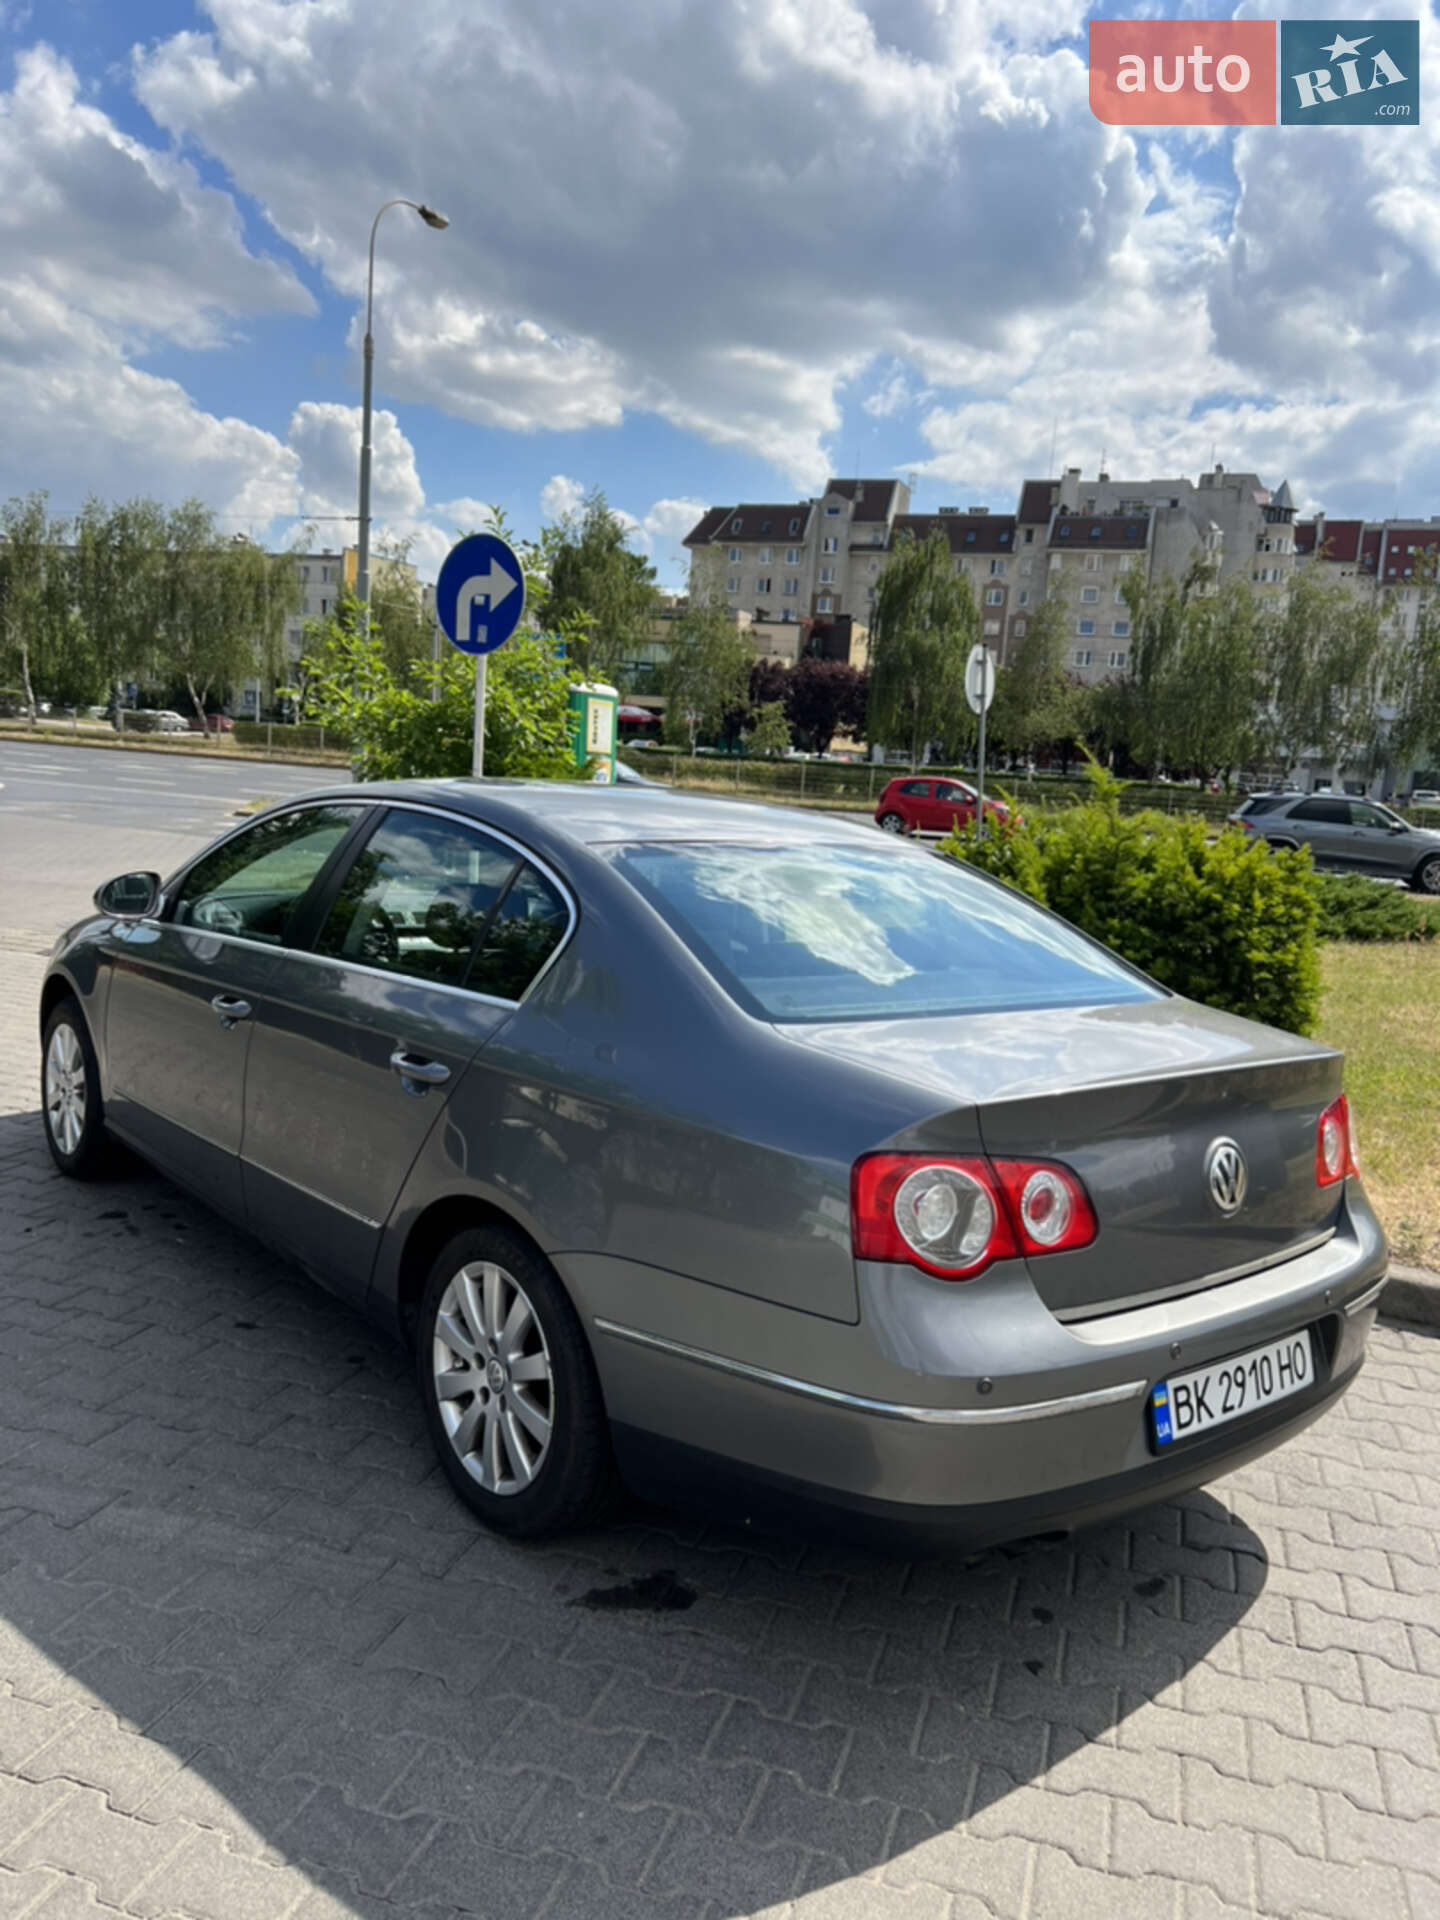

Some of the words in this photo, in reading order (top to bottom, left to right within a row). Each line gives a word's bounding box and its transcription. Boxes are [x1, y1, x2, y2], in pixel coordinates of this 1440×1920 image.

[1173, 1376, 1215, 1430] BK
[1219, 1355, 1274, 1414] 2910
[1276, 1341, 1306, 1389] HO
